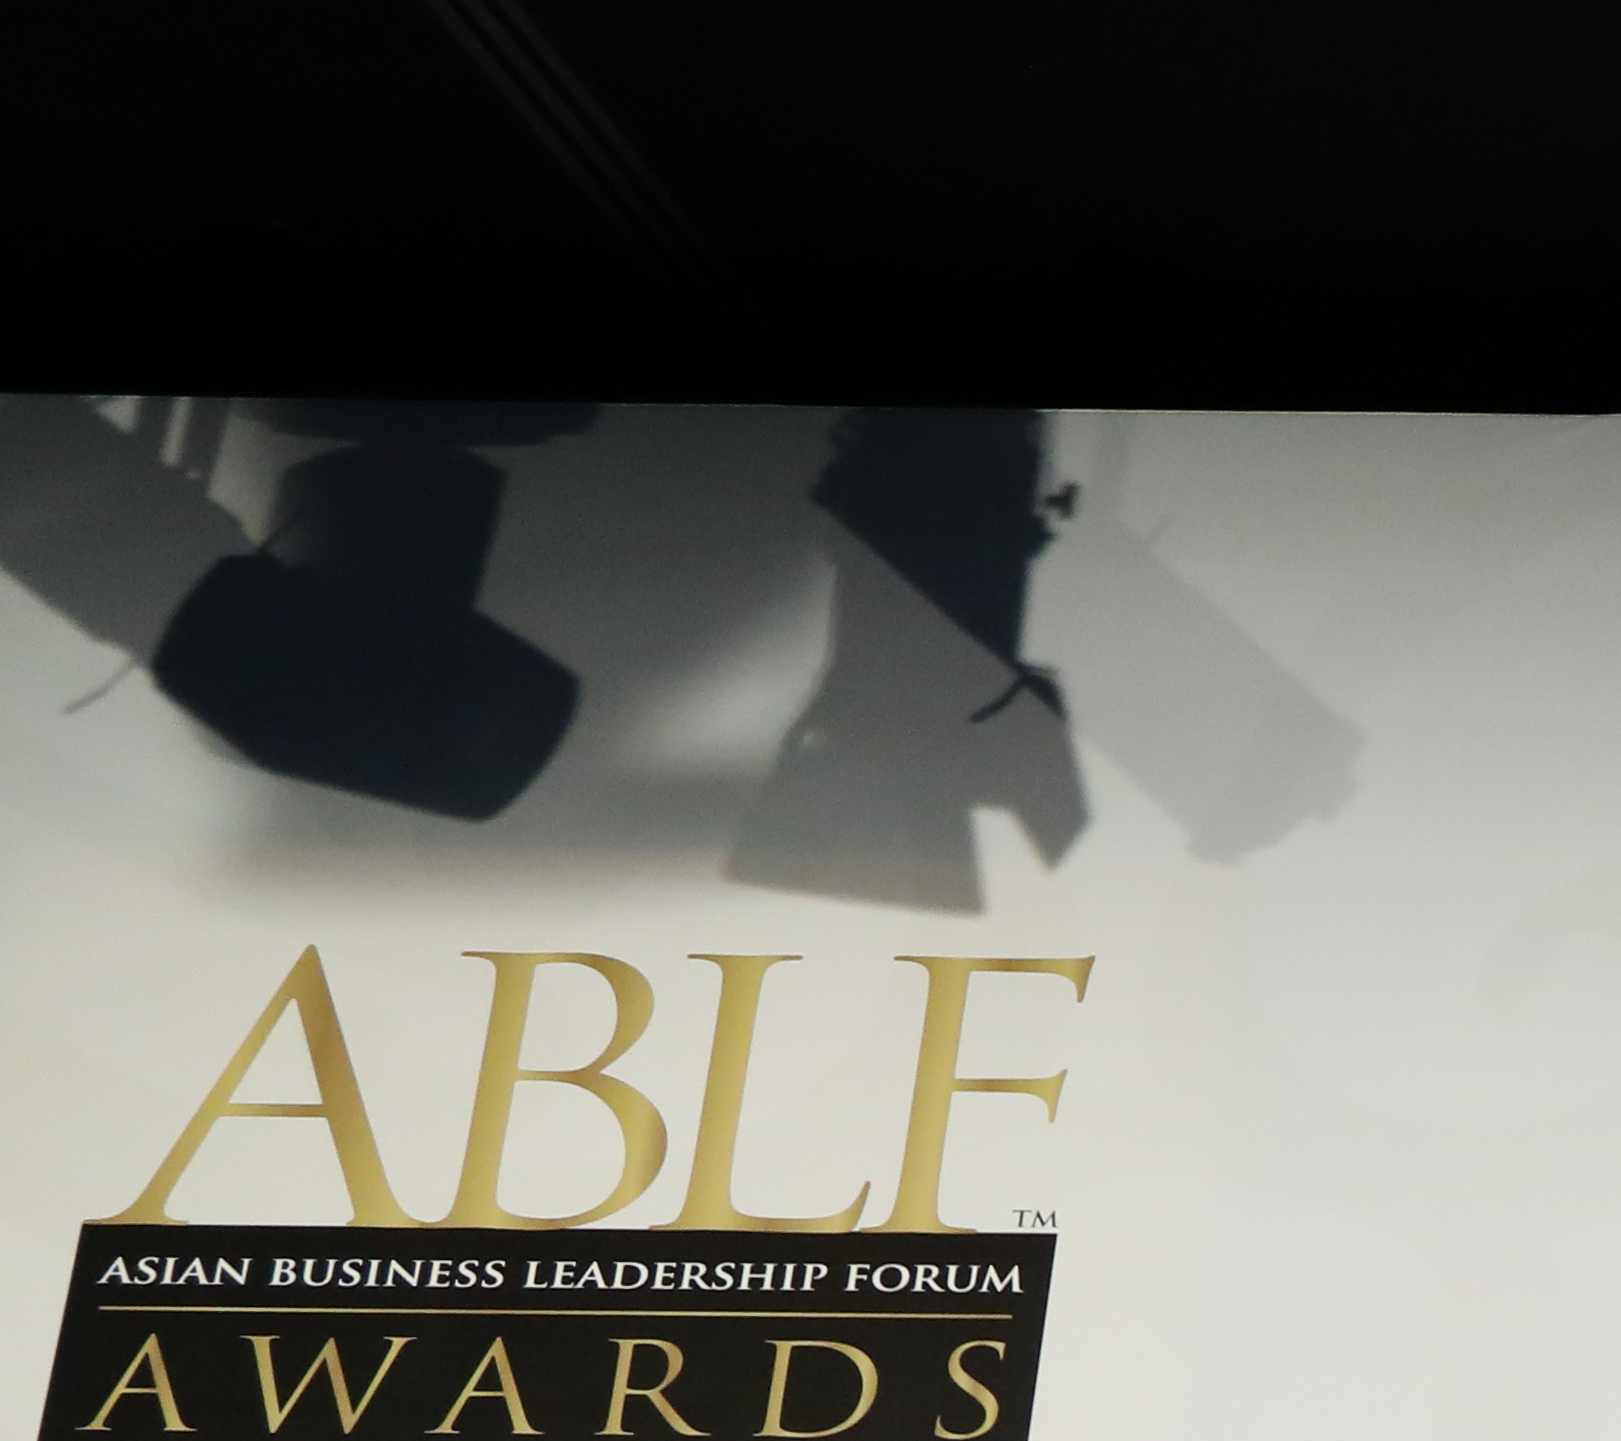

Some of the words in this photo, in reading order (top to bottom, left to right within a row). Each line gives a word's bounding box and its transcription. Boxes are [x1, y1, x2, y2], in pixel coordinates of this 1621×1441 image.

[81, 943, 1096, 1236] ABLF
[96, 1257, 252, 1288] ASIAN
[270, 1258, 507, 1290] BUSINESS
[523, 1261, 831, 1294] LEADERSHIP
[846, 1263, 1026, 1296] FORUM
